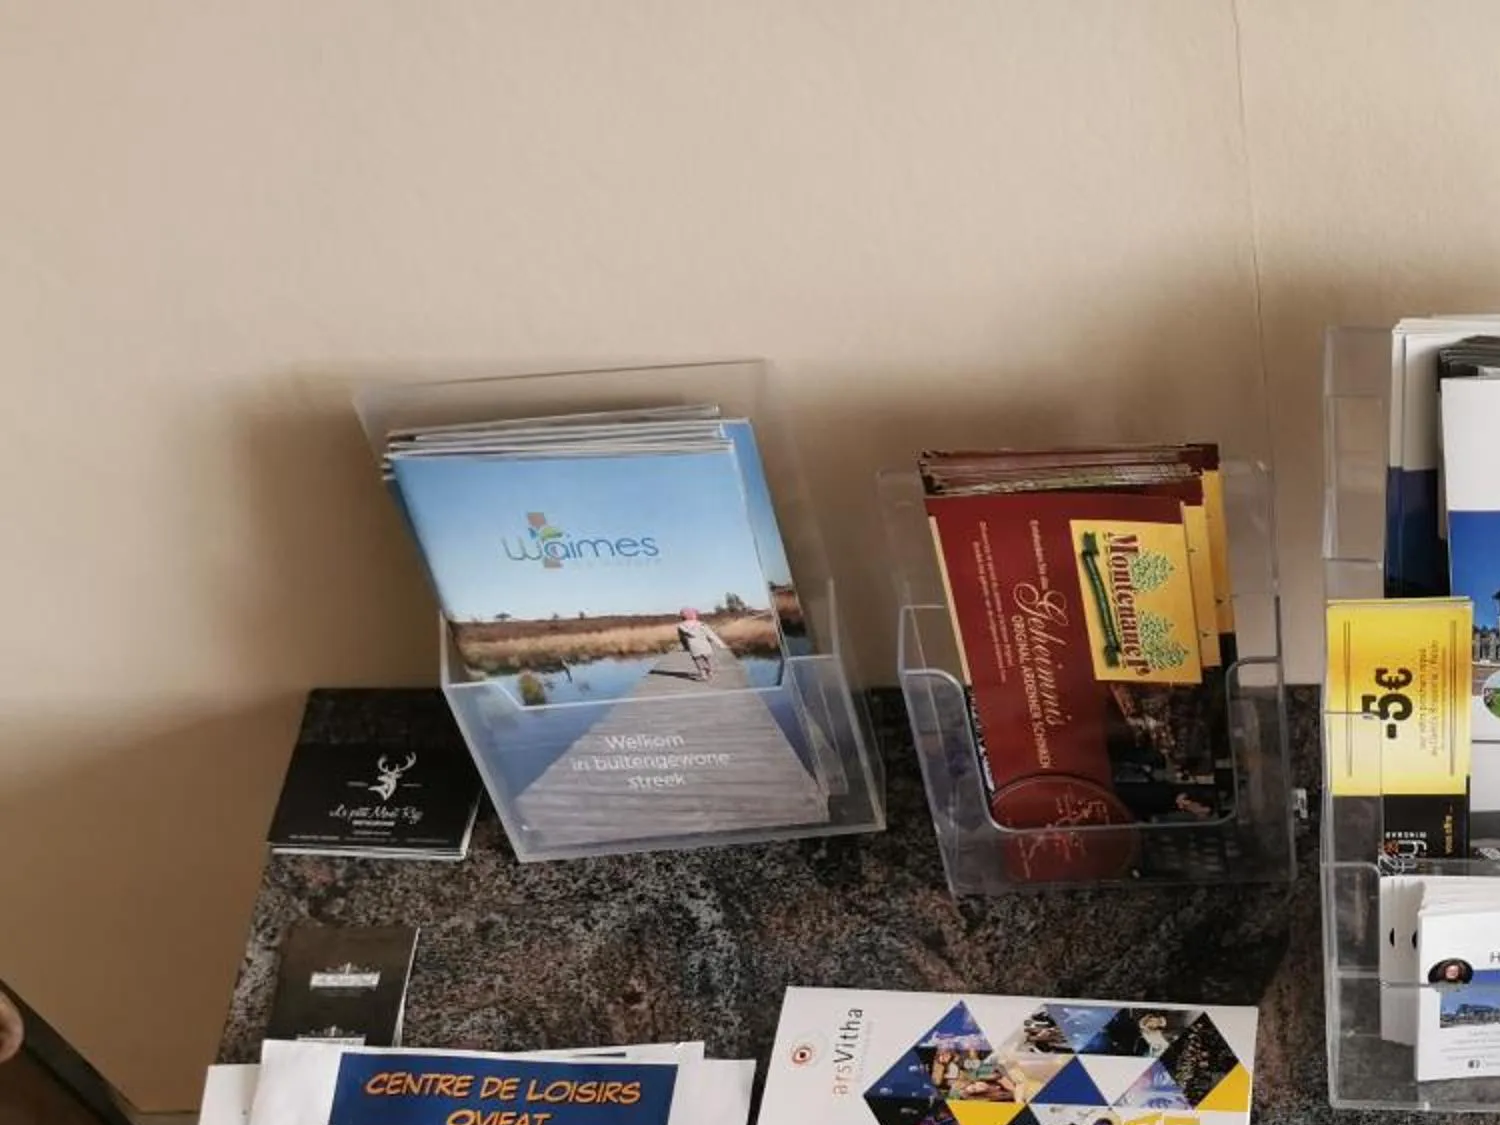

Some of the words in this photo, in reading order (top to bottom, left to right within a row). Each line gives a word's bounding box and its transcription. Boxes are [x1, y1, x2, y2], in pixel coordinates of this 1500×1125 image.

[502, 534, 660, 562] Waimes
[1010, 615, 1030, 662] ORIGINAL
[1013, 581, 1074, 728] Geheimnis
[605, 734, 685, 750] Welkom
[570, 758, 590, 771] in
[594, 752, 731, 770] buitengewone
[627, 774, 686, 790] streek
[365, 1072, 472, 1099] CENTRE
[480, 1075, 520, 1100] DE
[526, 1078, 641, 1105] LOISIRS
